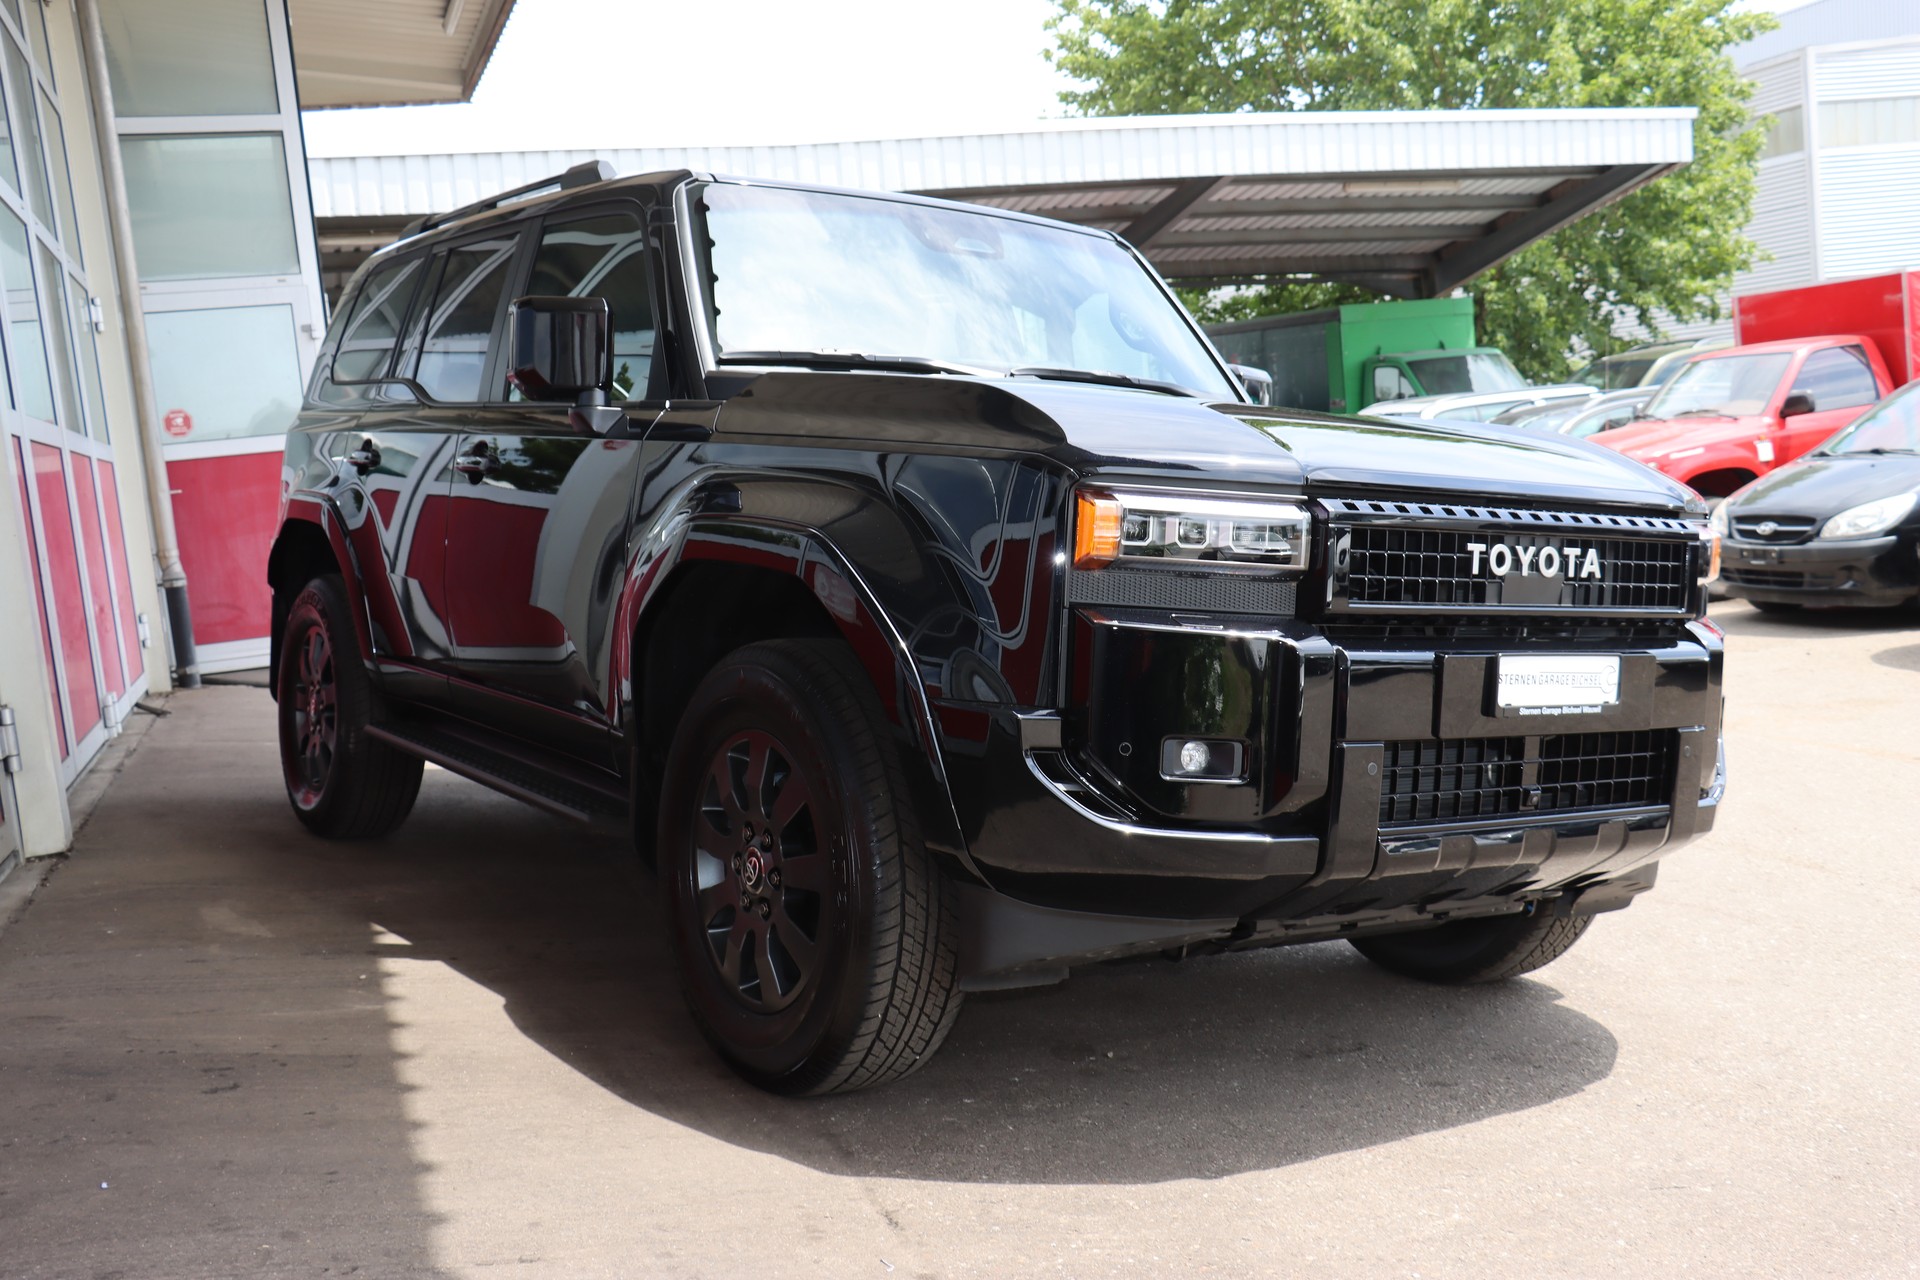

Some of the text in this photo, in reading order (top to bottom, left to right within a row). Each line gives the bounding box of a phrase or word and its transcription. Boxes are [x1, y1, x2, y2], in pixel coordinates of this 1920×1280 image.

[1467, 543, 1601, 578] TOYOTA
[1498, 673, 1602, 686] STERNEN GARAGE BICHSEL
